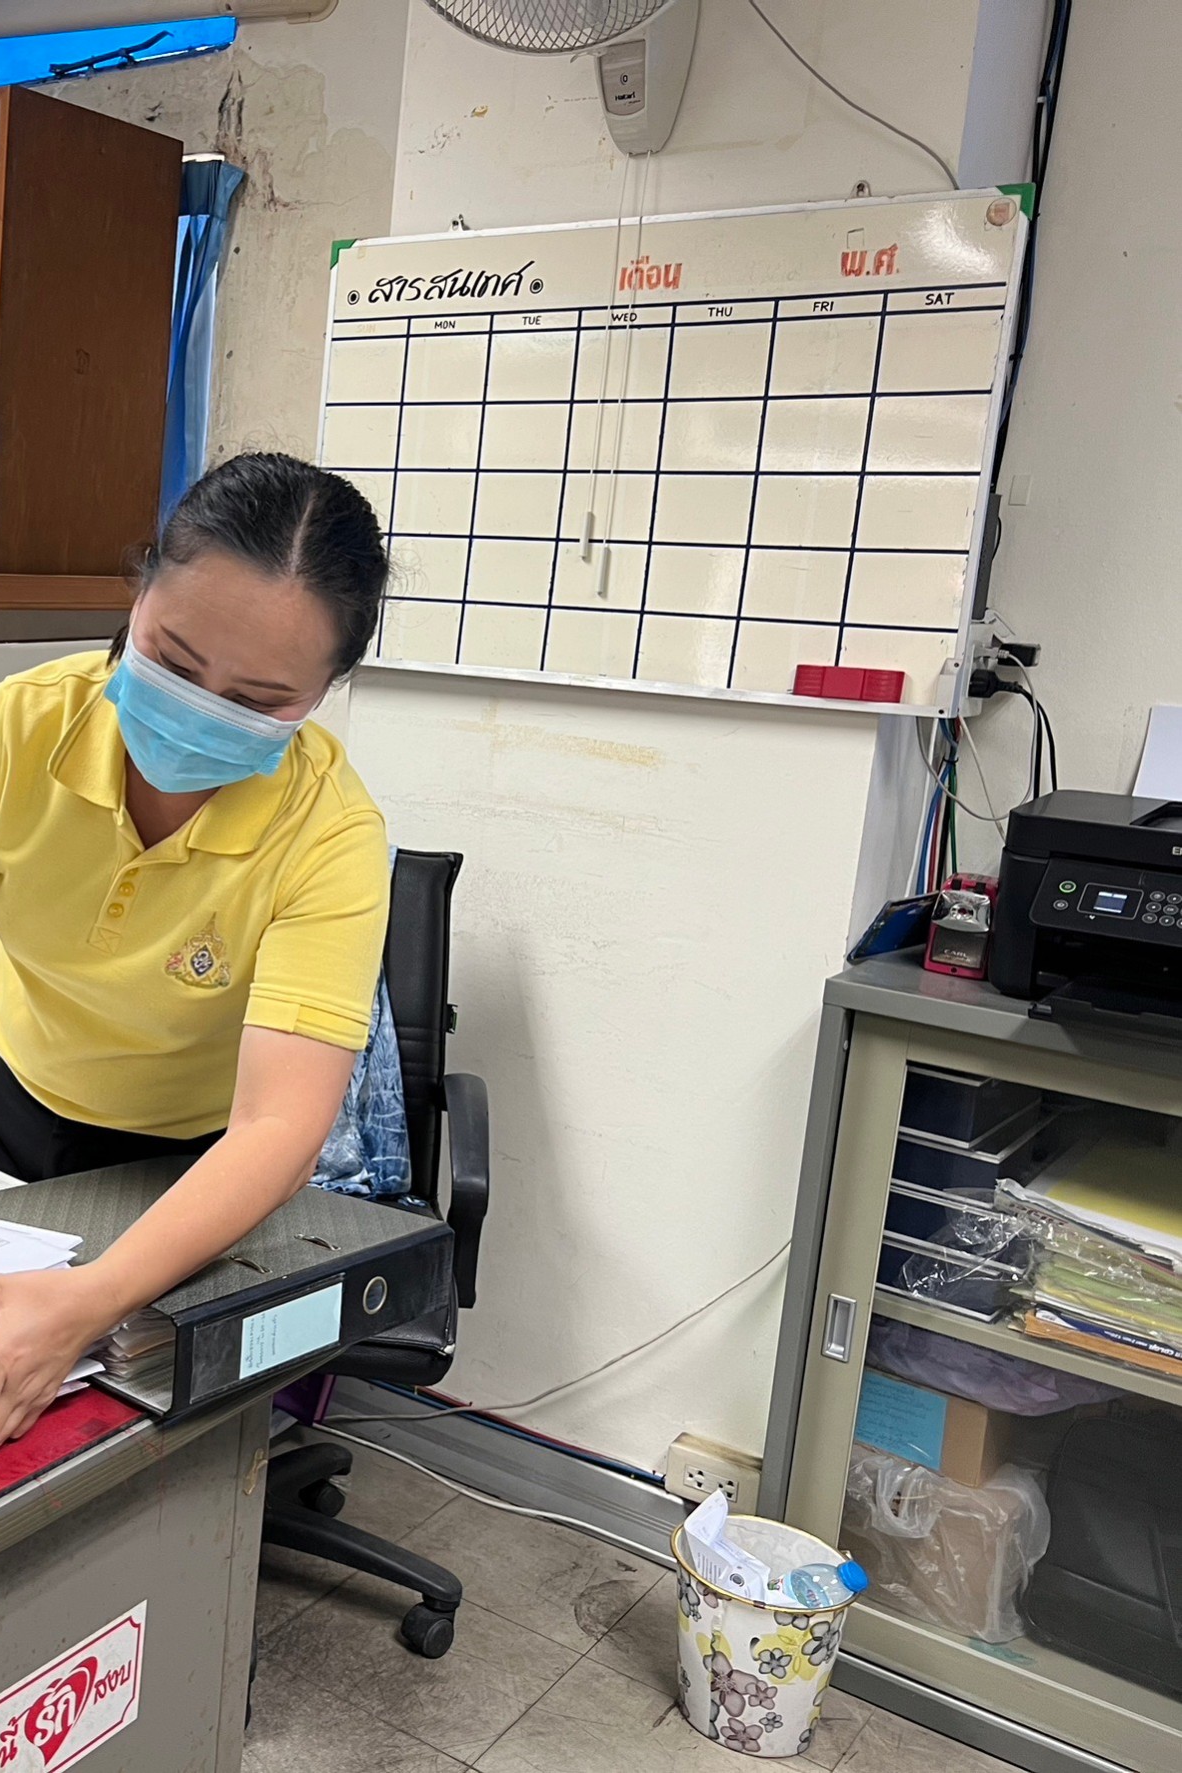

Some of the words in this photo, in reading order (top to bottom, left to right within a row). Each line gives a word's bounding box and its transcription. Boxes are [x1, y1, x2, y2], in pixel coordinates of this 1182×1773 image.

[367, 260, 536, 304] สารสนเทศ
[924, 292, 955, 306] SAT
[707, 306, 734, 318] THU
[812, 301, 835, 313] FRI
[521, 315, 543, 327] TUE
[610, 312, 638, 323] WED
[433, 320, 457, 331] MON
